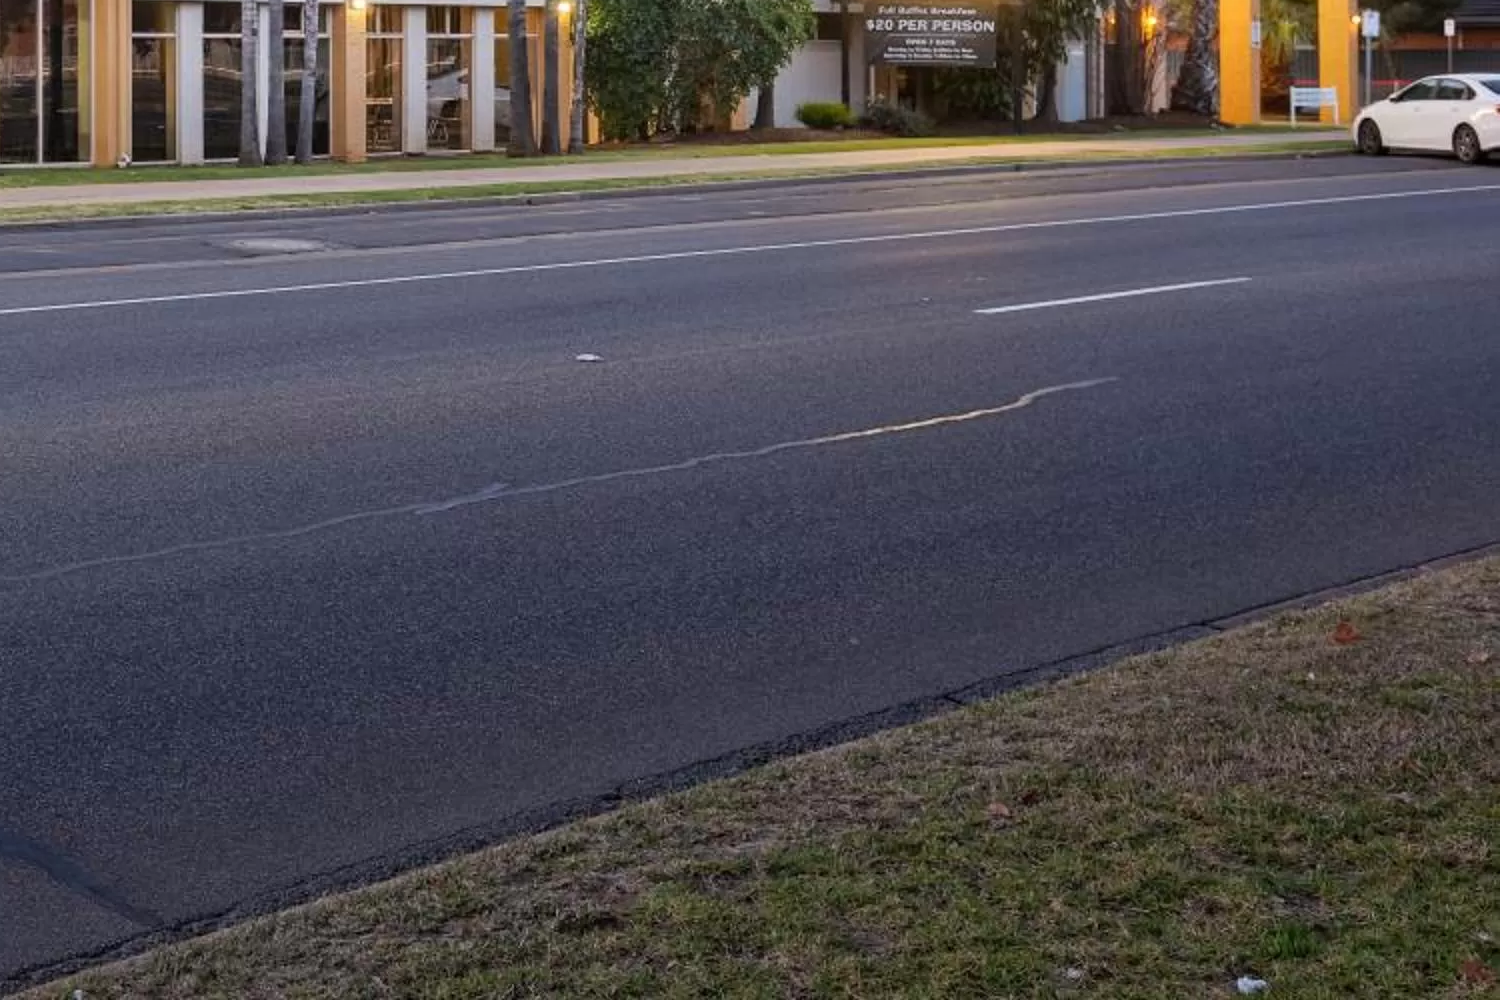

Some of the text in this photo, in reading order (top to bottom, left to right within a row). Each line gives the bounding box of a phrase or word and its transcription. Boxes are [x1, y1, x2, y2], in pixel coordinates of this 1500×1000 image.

[866, 19, 995, 32] $20 PER PERSON
